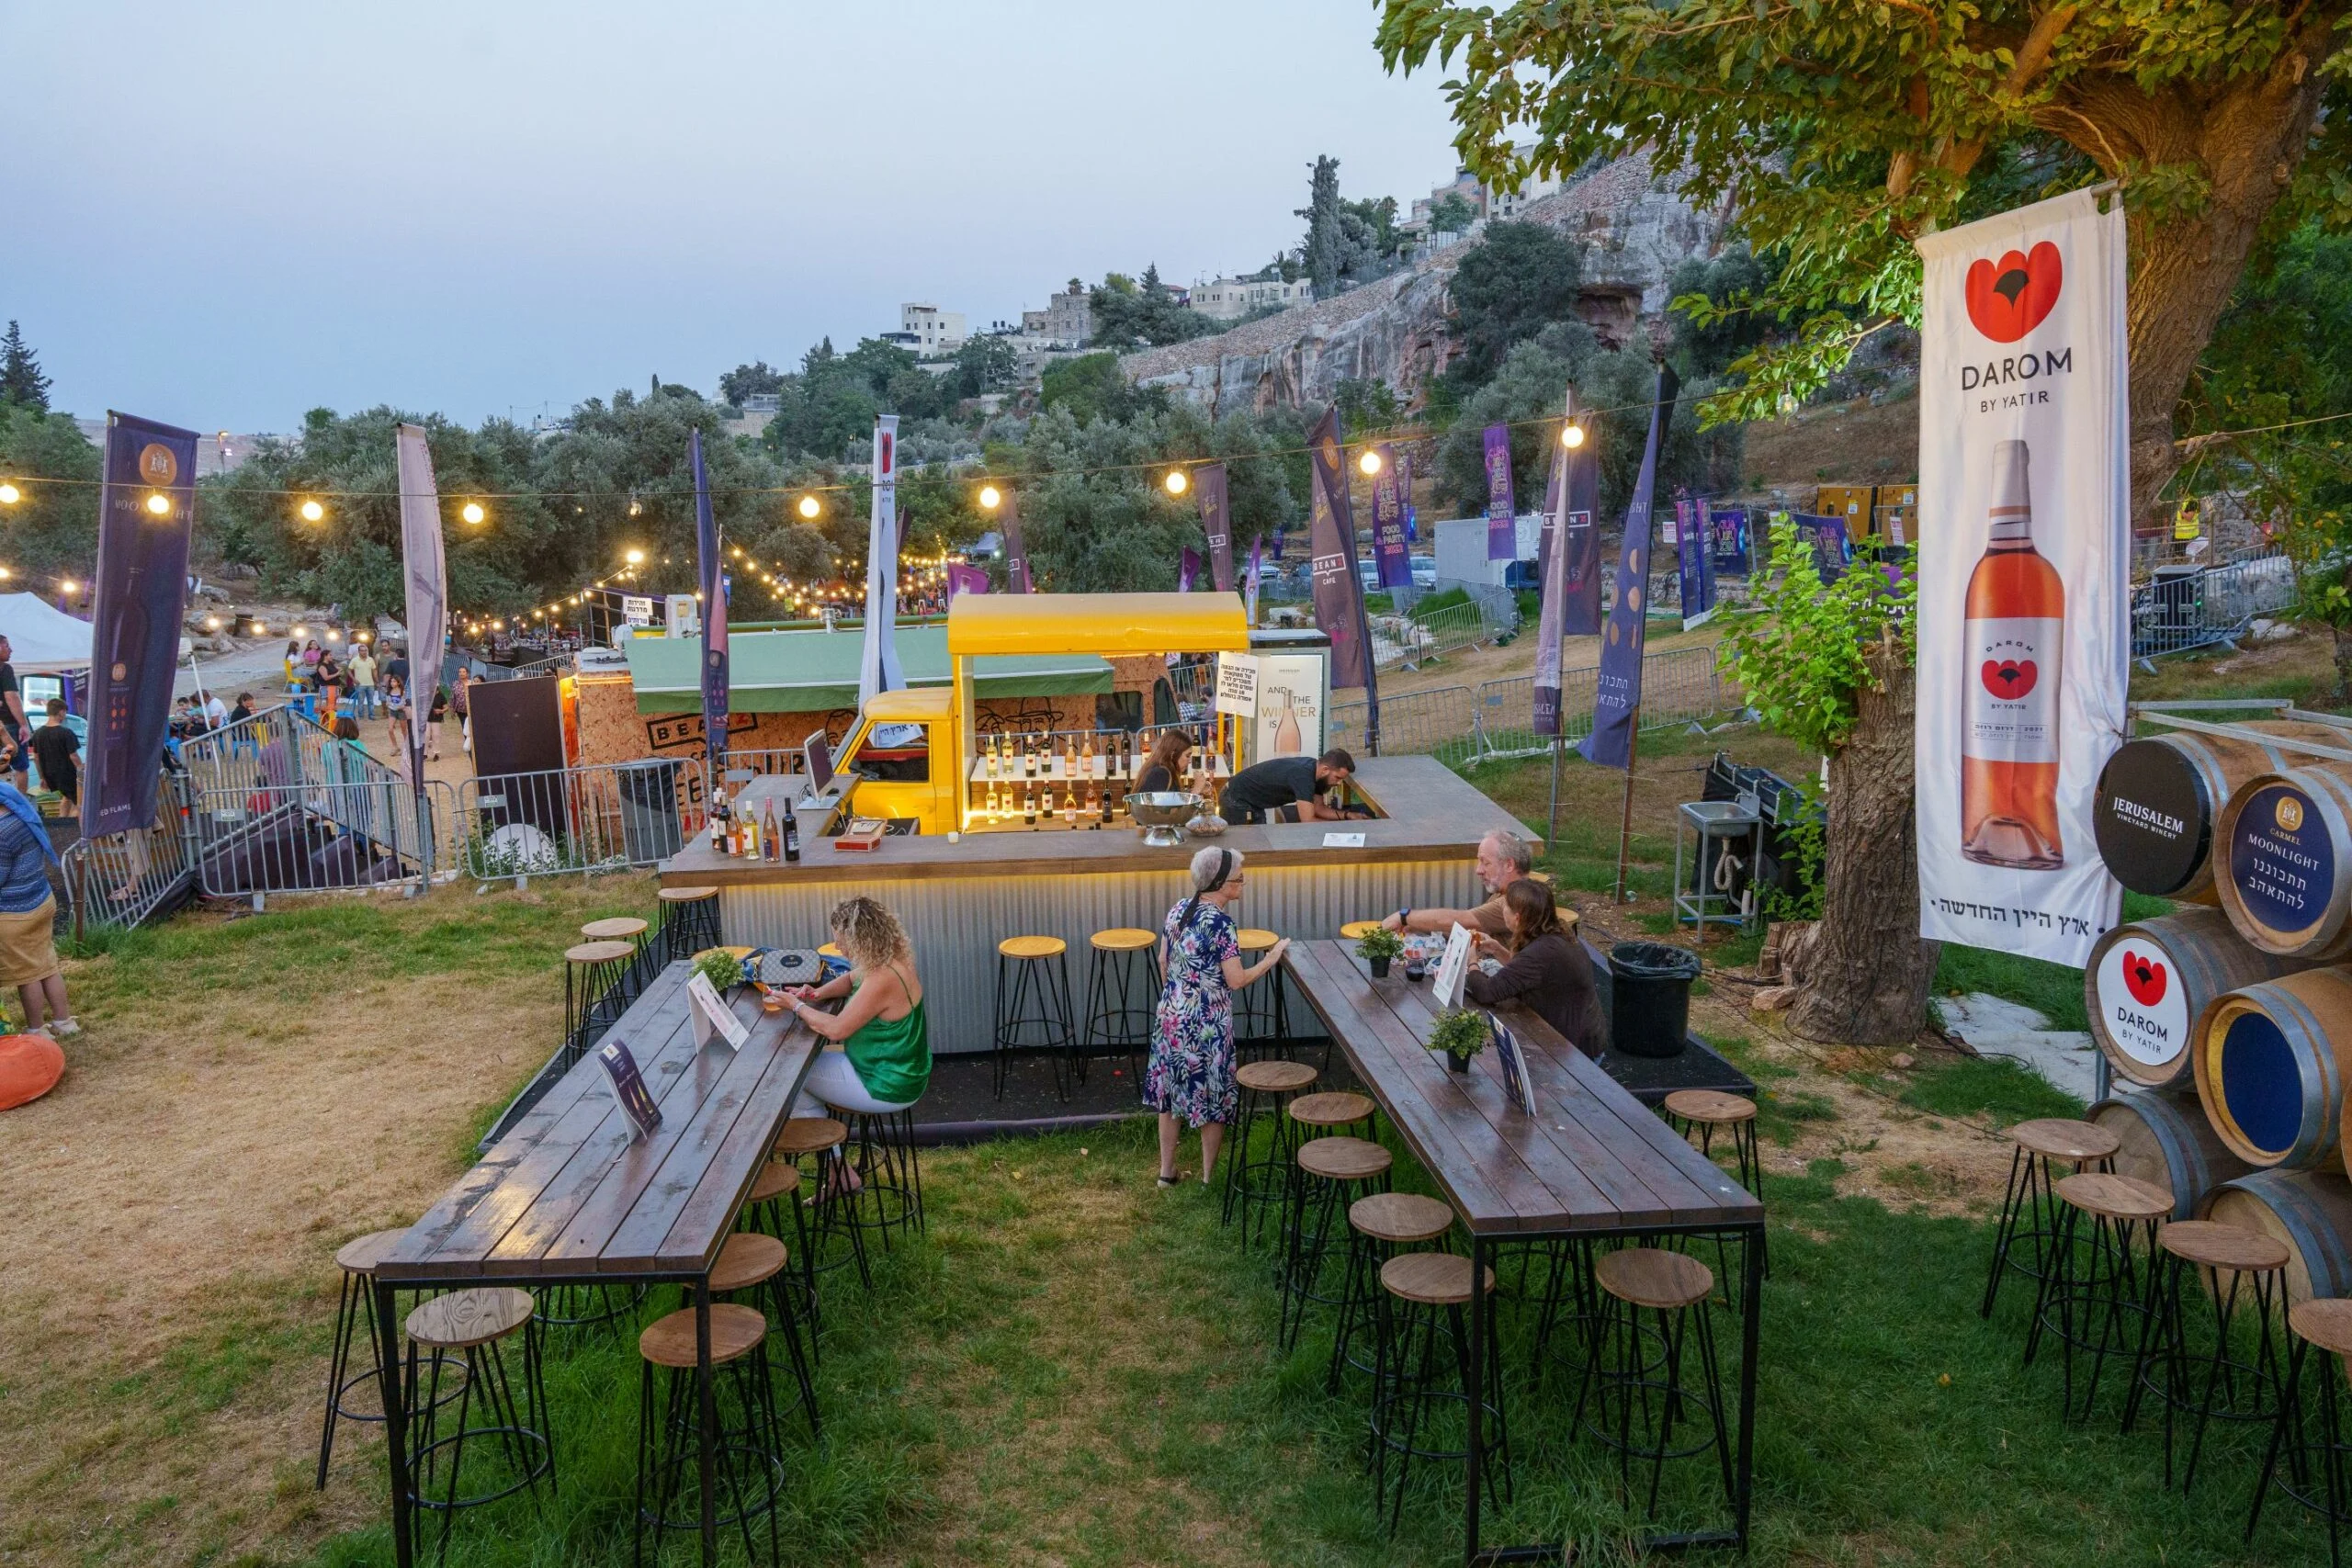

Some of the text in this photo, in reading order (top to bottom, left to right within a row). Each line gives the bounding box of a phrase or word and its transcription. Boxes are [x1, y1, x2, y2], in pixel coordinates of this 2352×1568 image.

[1962, 346, 2072, 391] DAROM
[1980, 389, 2050, 413] BY YATIR
[115, 499, 192, 521] MOOHT
[1985, 639, 2034, 653] DAROM
[1267, 686, 1287, 694] AND
[1600, 674, 1628, 689] תתכונ
[1293, 695, 1311, 705] THE
[1599, 694, 1626, 709] להתא
[1269, 720, 1277, 728] IS
[2113, 796, 2183, 834] JERUSALEM
[2117, 812, 2177, 840] VINEYARD WINERY
[2269, 827, 2301, 846] CARMEL
[2248, 833, 2320, 871] MOONLIGHT
[2254, 858, 2306, 891] תתכוננו
[2248, 876, 2304, 909] להתאהב
[1939, 897, 2089, 937] ארץ היין החדשה
[2118, 1006, 2167, 1042] DAROM
[2122, 1029, 2161, 1055] BY YATIR
